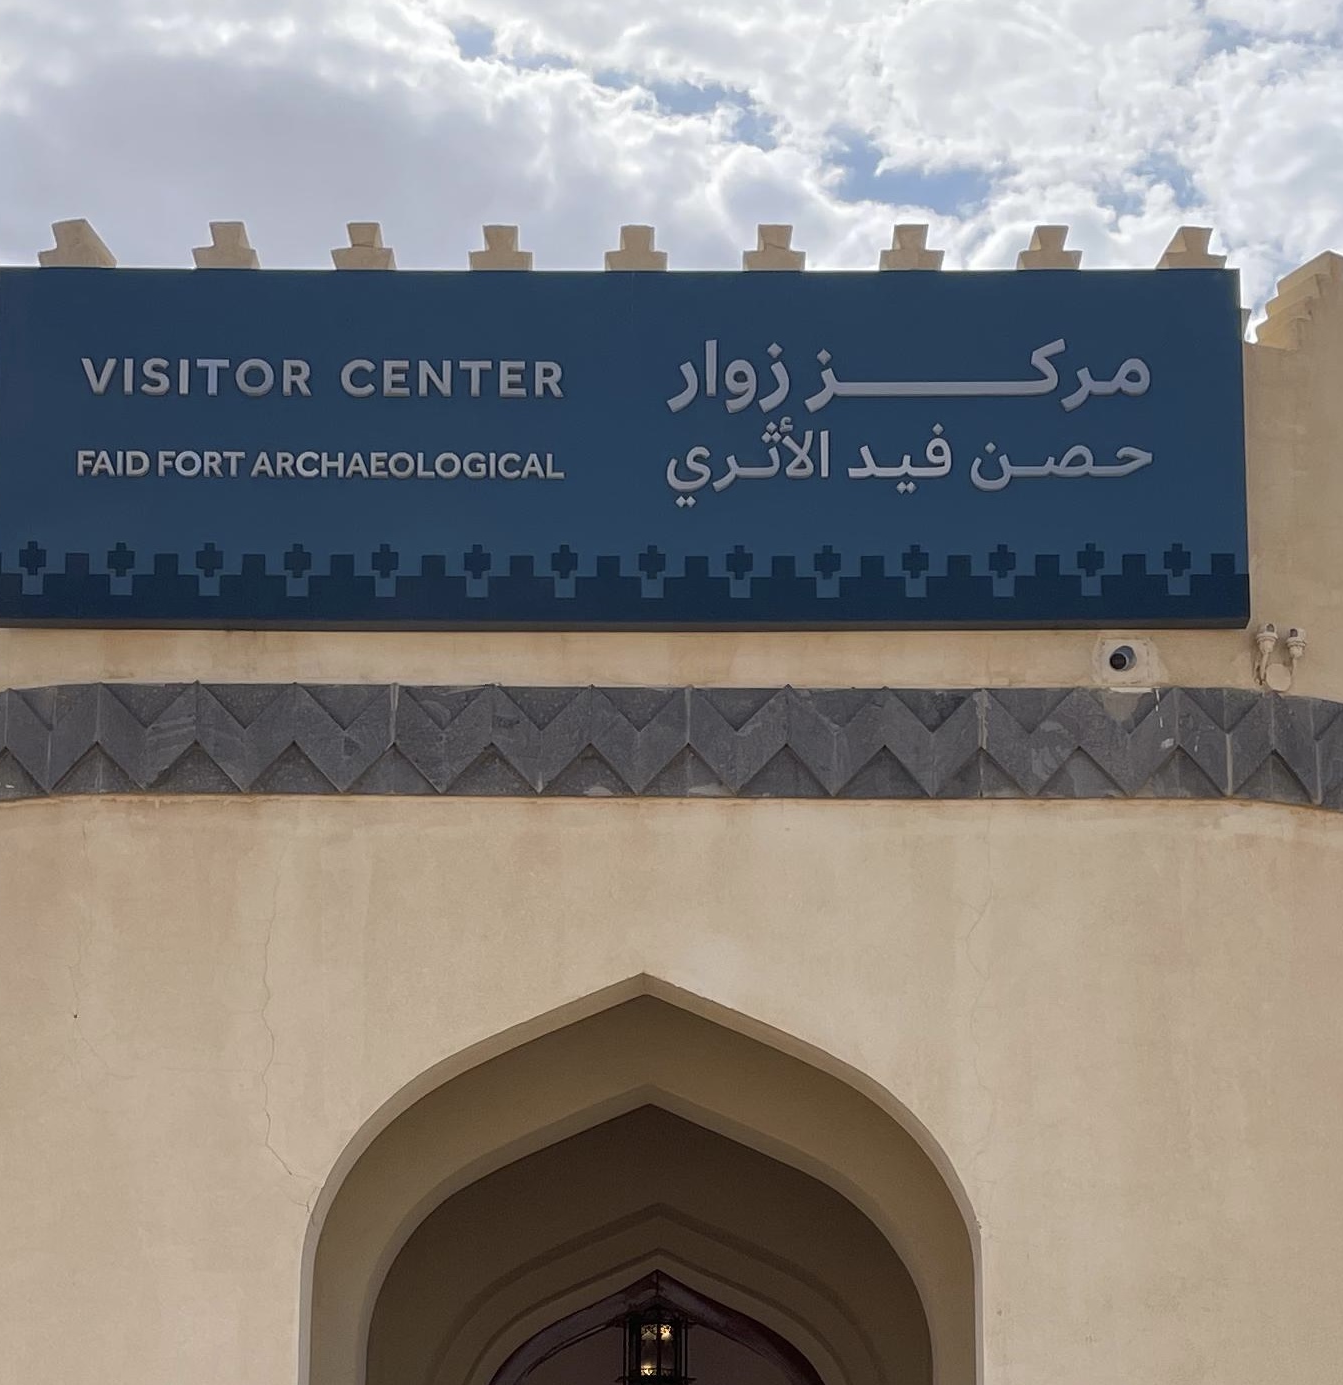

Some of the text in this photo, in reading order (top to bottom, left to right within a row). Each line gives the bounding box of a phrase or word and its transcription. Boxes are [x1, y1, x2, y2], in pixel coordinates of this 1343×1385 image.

[81, 357, 565, 399] VISITOR CENTER
[666, 337, 1151, 414] مركز زوار
[76, 449, 566, 480] FAID FORT ARCHAEOLOGICAL
[665, 416, 1155, 509] حصن فيد الأثري
